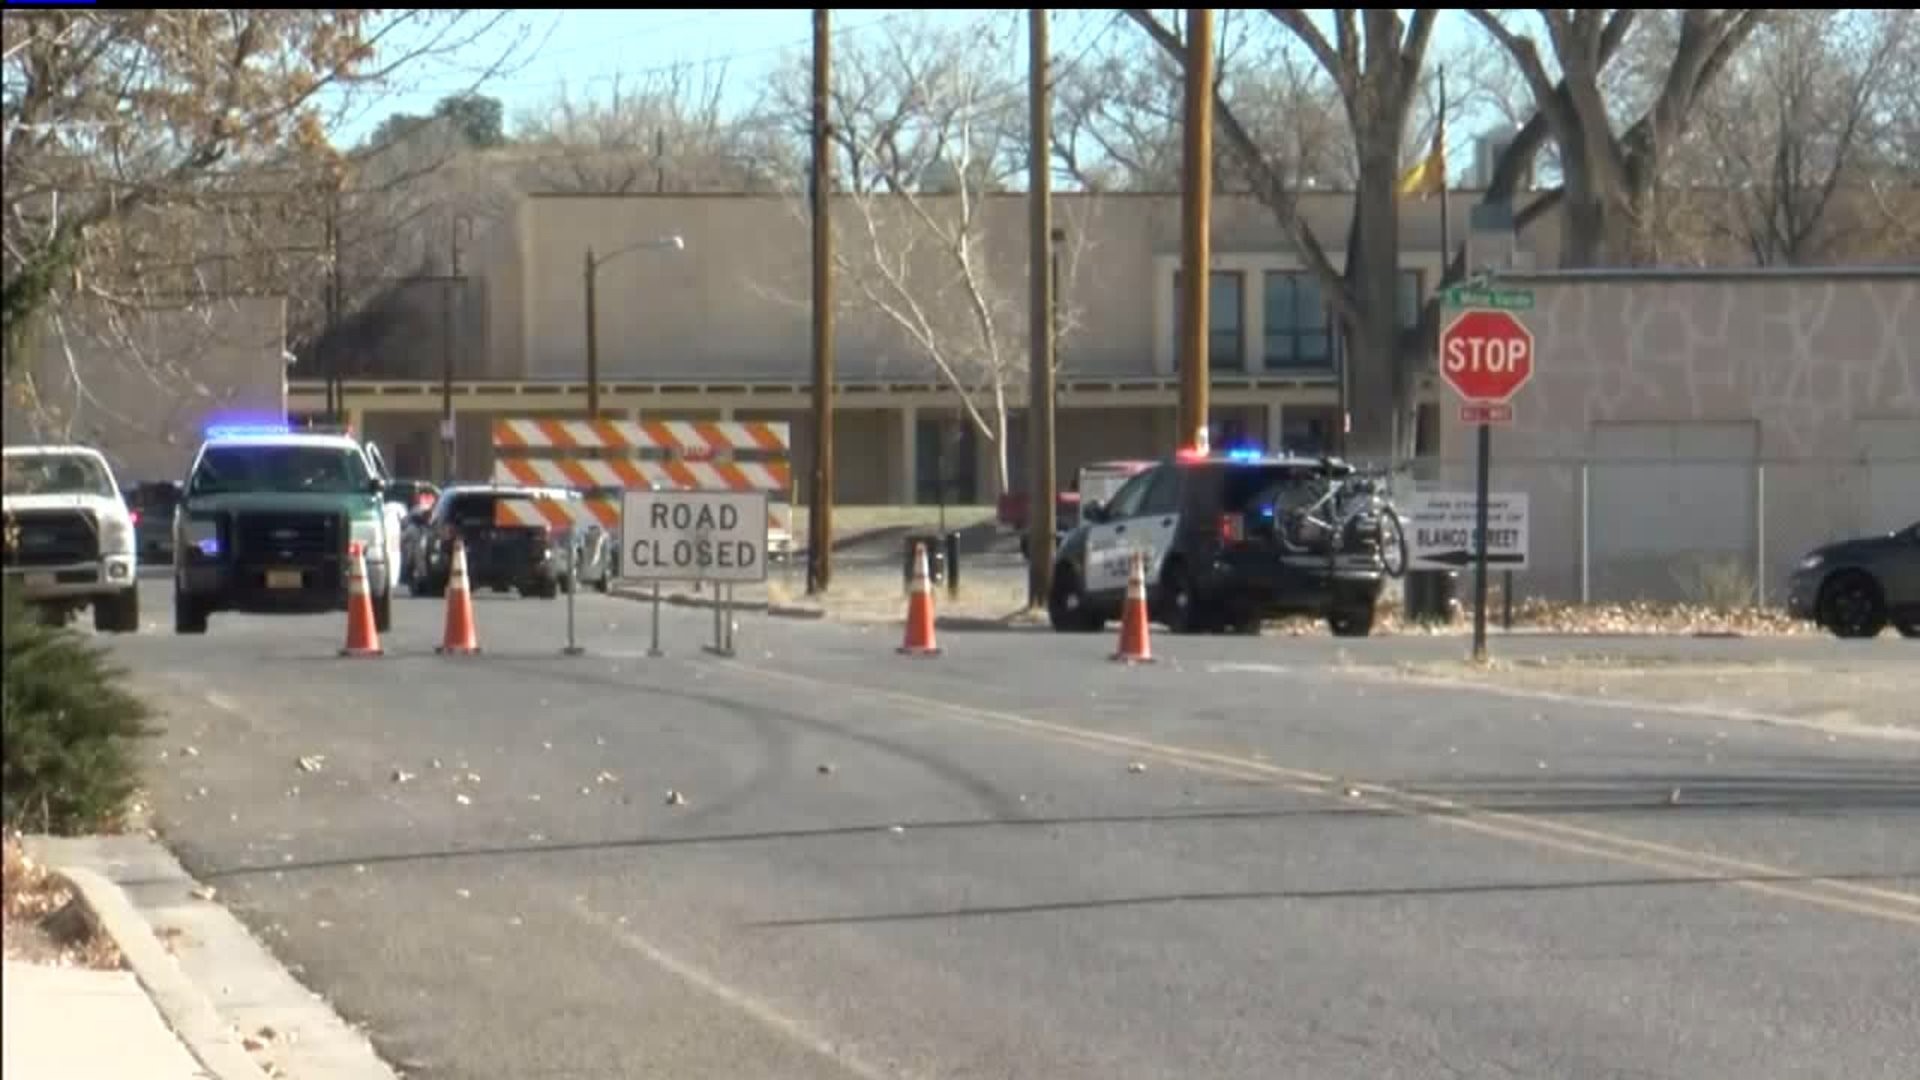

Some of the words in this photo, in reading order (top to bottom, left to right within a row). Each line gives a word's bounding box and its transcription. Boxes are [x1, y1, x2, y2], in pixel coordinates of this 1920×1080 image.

[1447, 337, 1526, 373] STOP
[651, 503, 738, 530] ROAD
[1471, 528, 1519, 548] SREET
[632, 539, 756, 567] CLOSED
